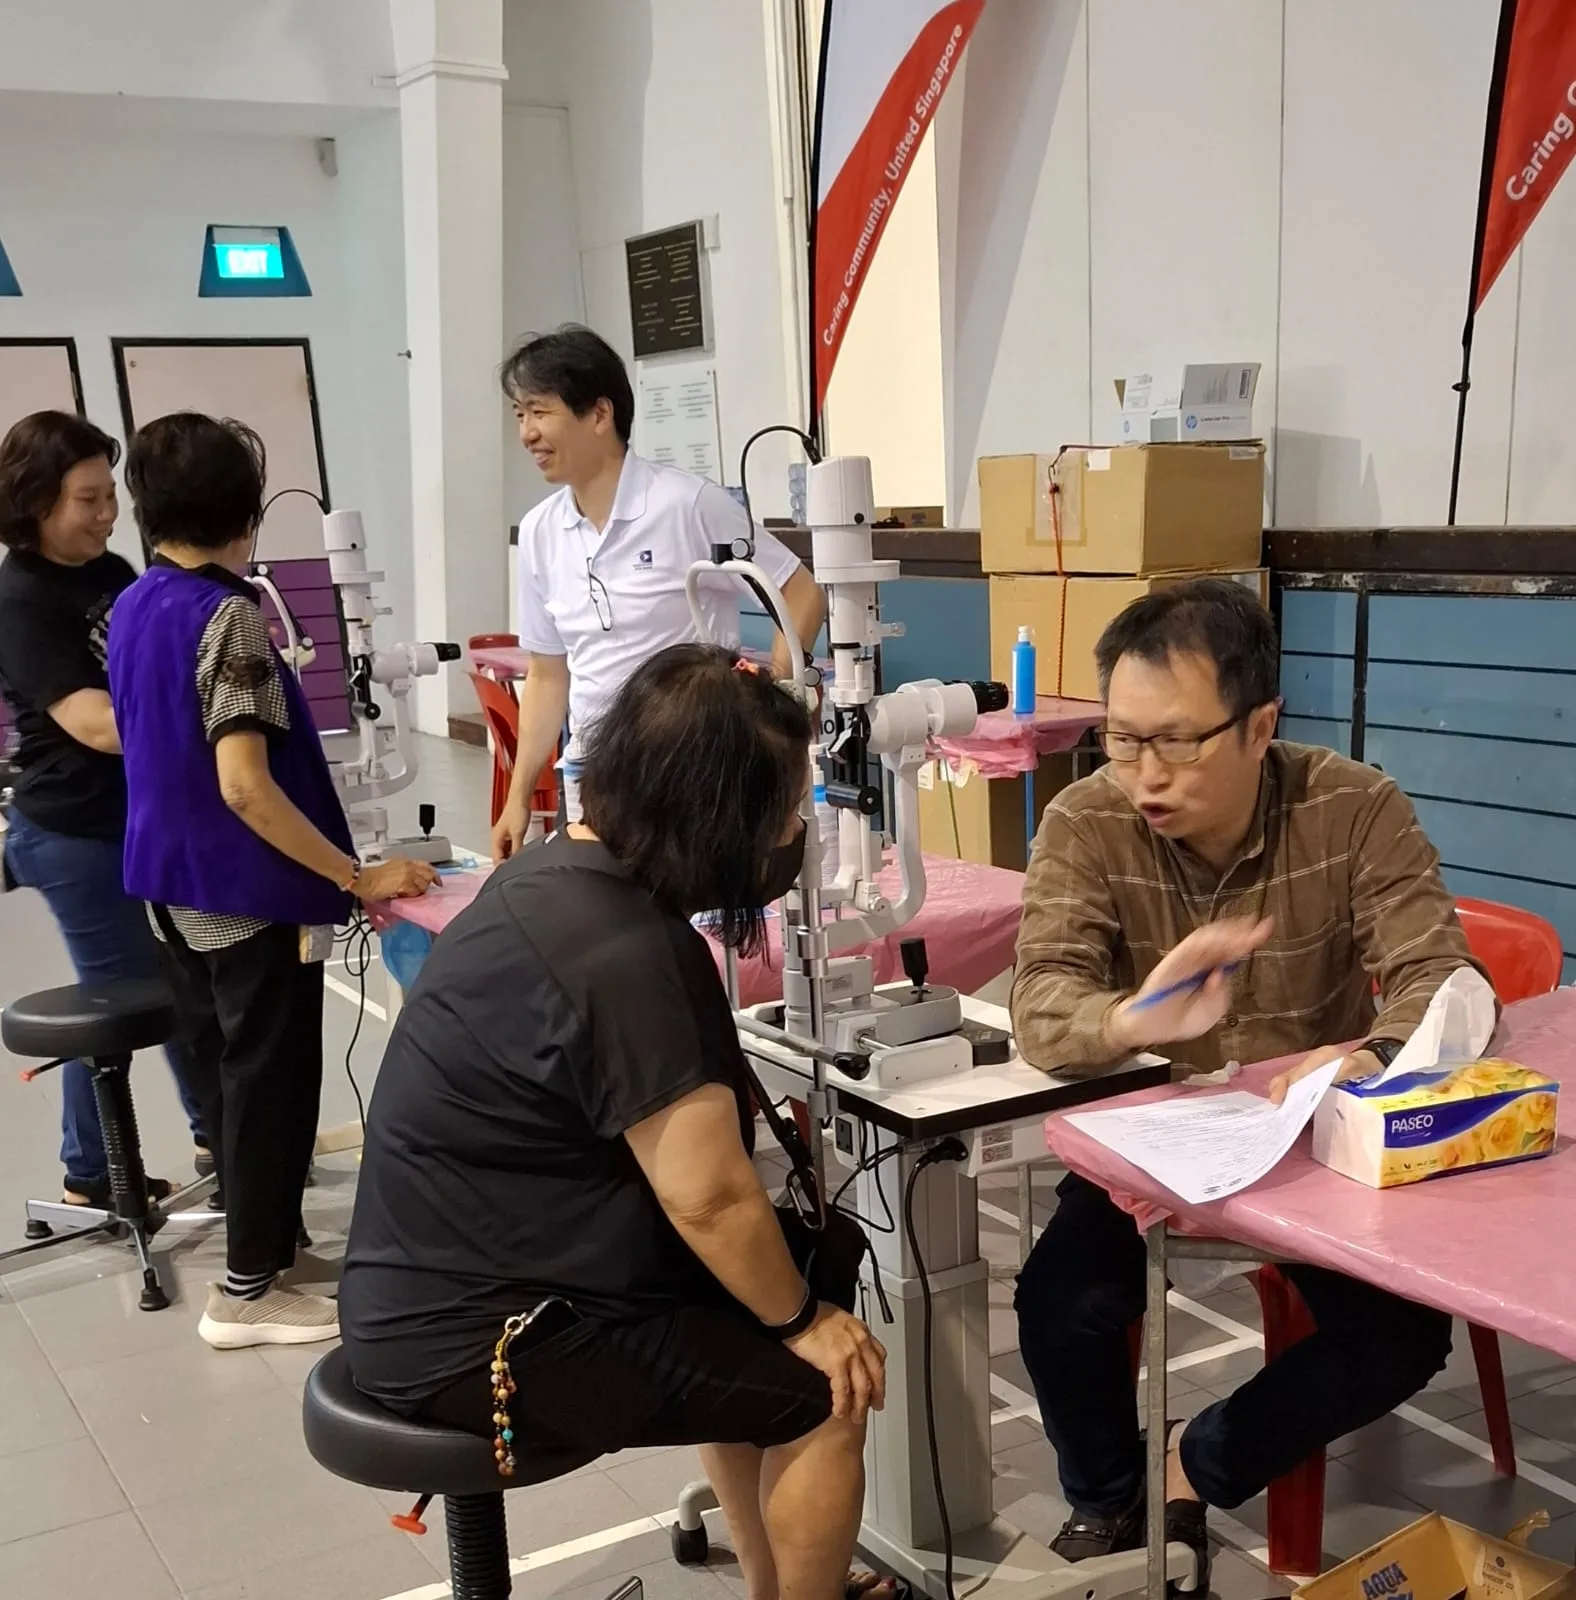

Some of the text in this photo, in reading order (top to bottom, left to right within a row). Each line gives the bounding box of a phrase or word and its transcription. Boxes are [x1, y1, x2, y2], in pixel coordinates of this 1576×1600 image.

[823, 24, 963, 346] Caring Community, United Singapore
[1505, 112, 1575, 201] Caring
[1391, 1114, 1434, 1134] PASEO
[1361, 1560, 1409, 1600] AQUA
